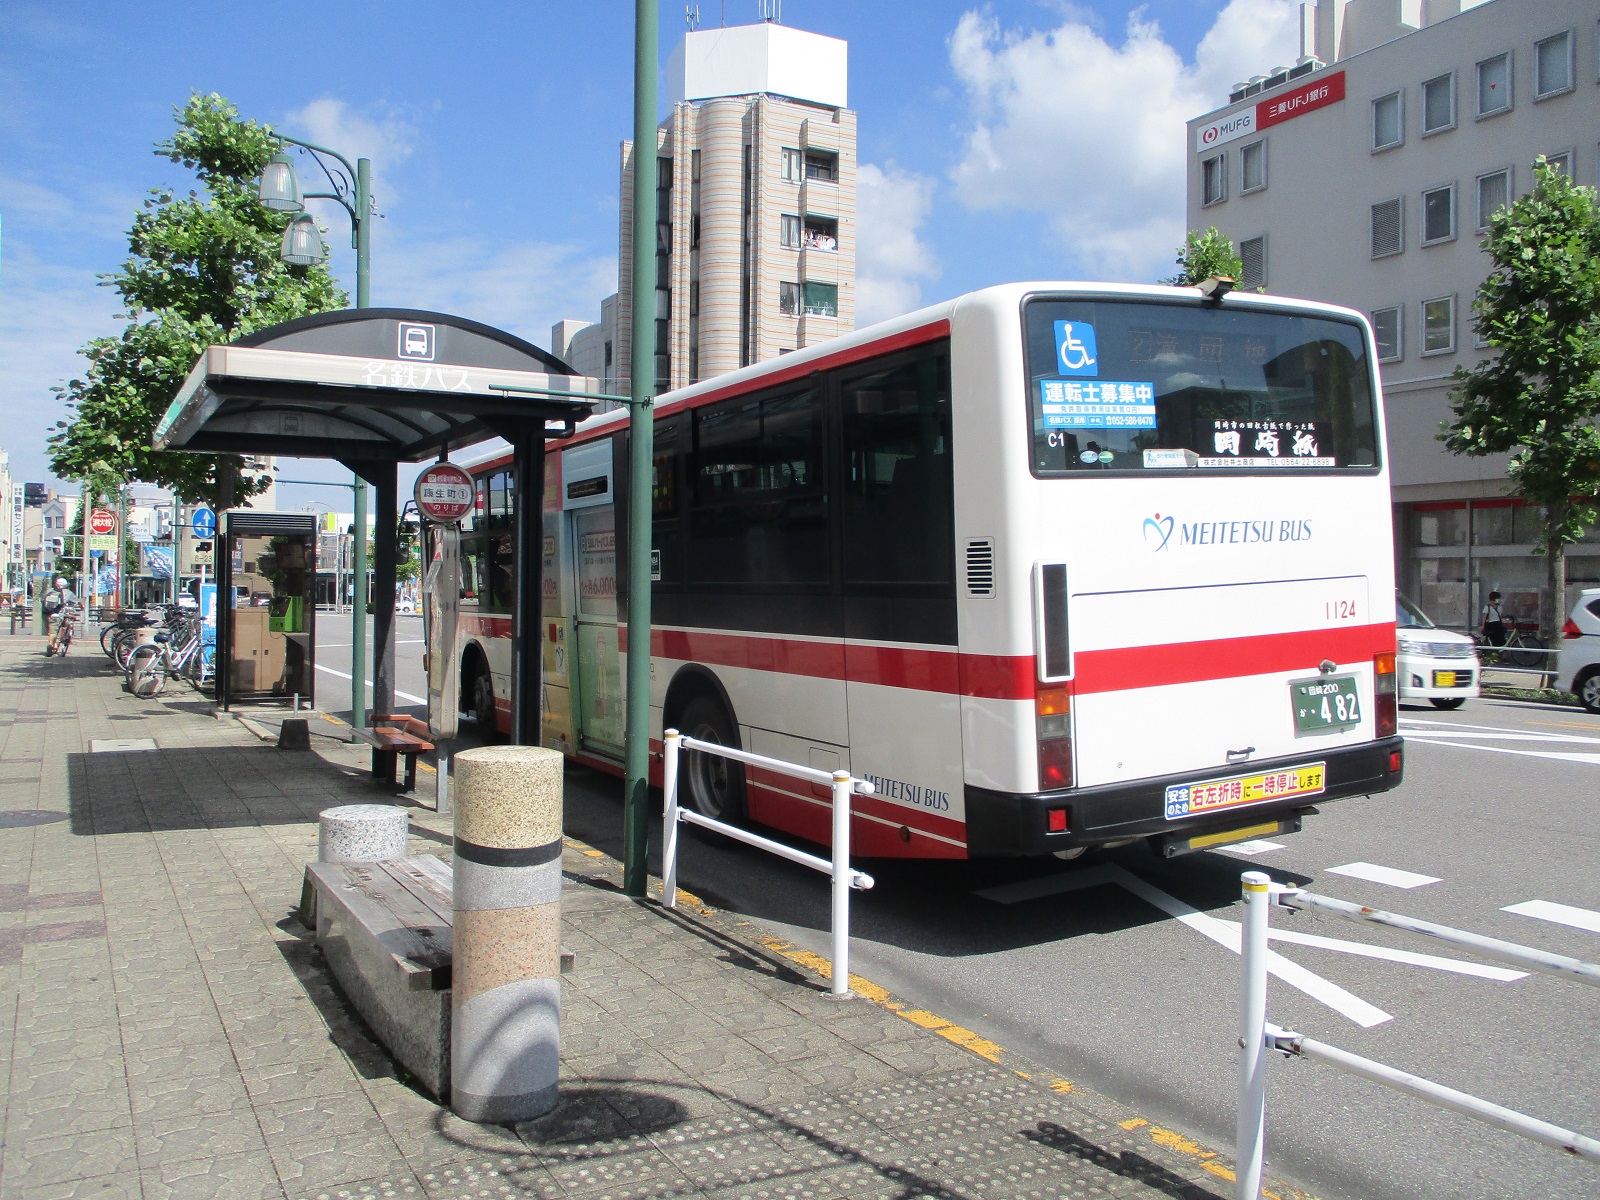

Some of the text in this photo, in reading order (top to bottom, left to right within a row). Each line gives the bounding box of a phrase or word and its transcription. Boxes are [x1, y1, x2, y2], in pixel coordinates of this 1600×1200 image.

[1269, 86, 1329, 118] 三菱UFJ銀行
[1220, 116, 1250, 136] MUFG
[361, 362, 472, 391] 名鉄バス
[1045, 383, 1152, 404] 運転士募集中
[1048, 432, 1065, 448] C1
[1214, 430, 1318, 457] 岡崎紙
[92, 518, 112, 527] 消火栓
[1180, 519, 1313, 545] MEITETSU BUS
[1326, 600, 1356, 620] 1124
[924, 788, 949, 811] BUS
[1167, 788, 1189, 803] 安全
[1192, 772, 1322, 807] 右左折時に一時停止します
[1167, 802, 1189, 815] のため
